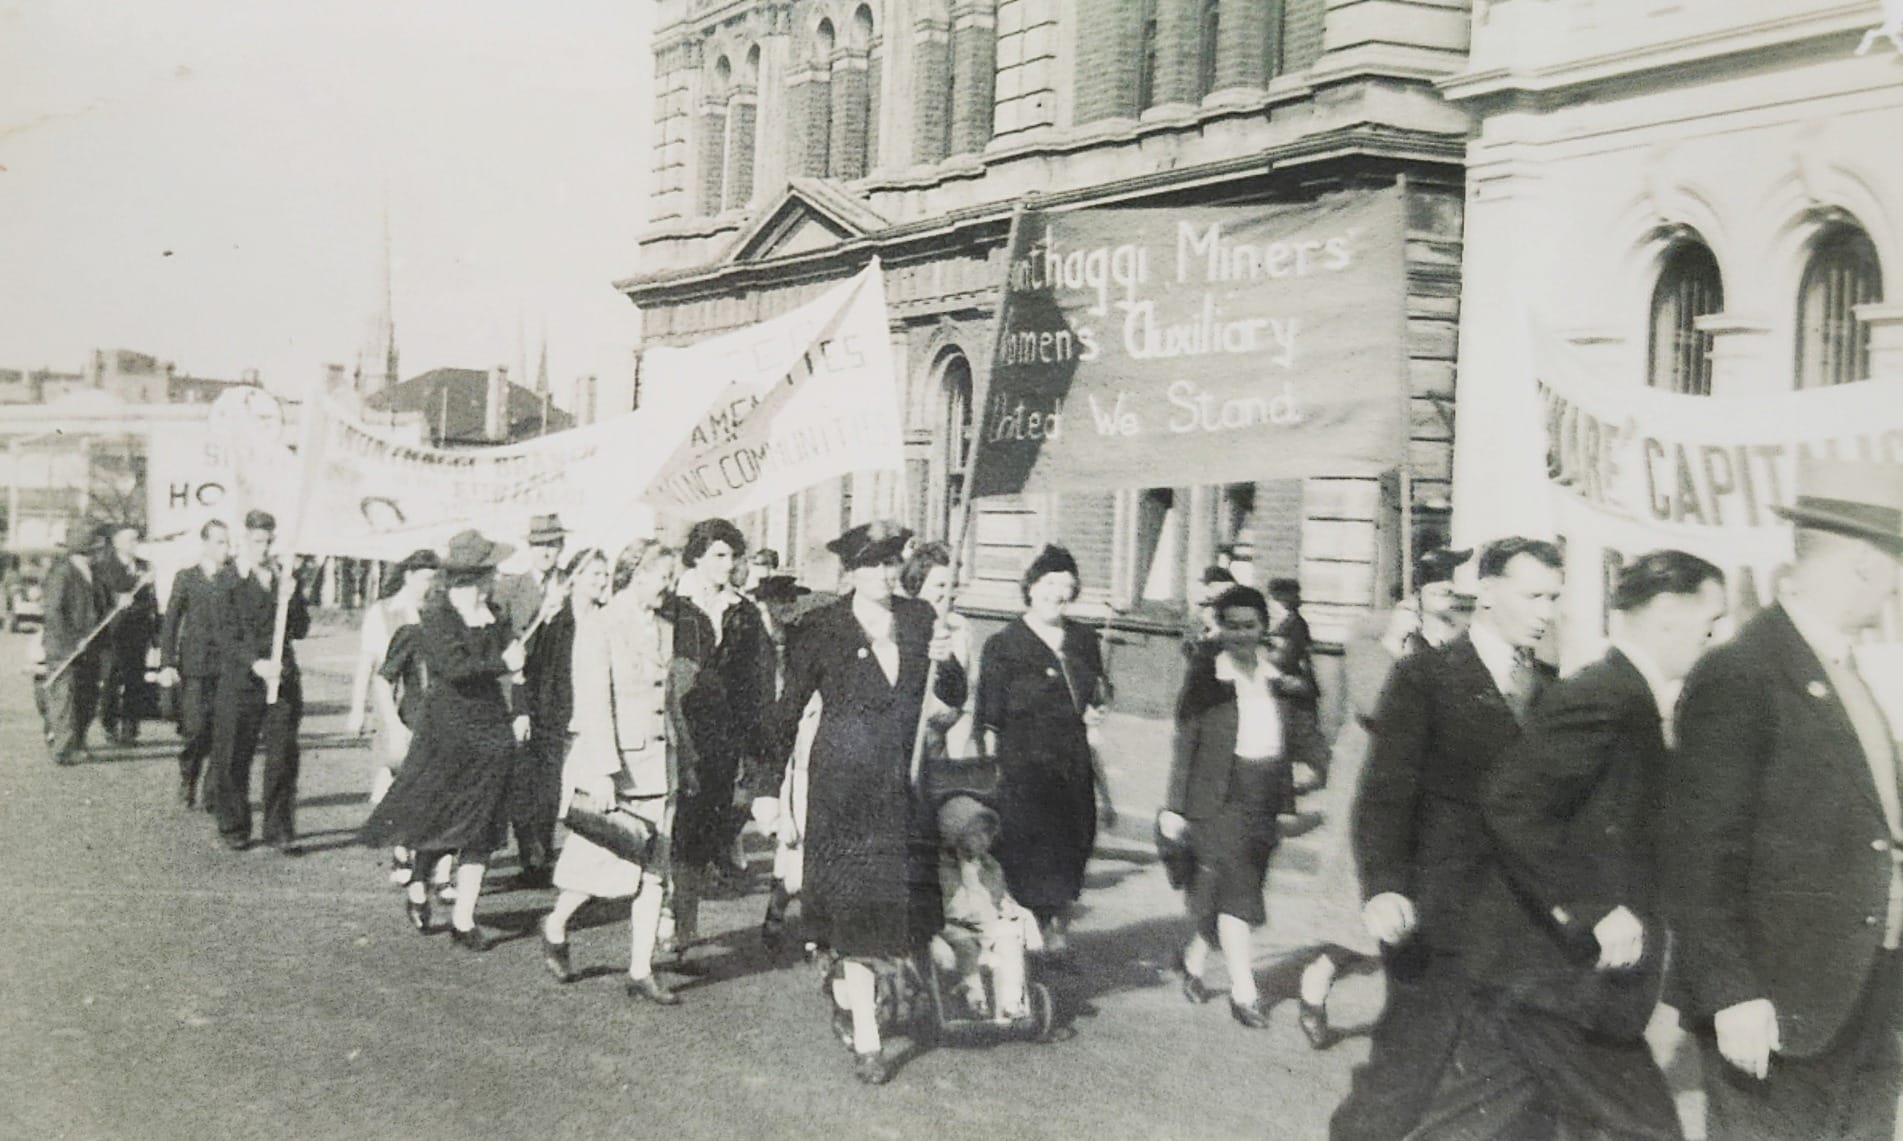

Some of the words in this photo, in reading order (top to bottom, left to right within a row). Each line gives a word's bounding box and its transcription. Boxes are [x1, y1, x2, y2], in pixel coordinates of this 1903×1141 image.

[1176, 219, 1370, 284] Miners'
[1088, 391, 1140, 437] We
[1167, 378, 1304, 434] Stand
